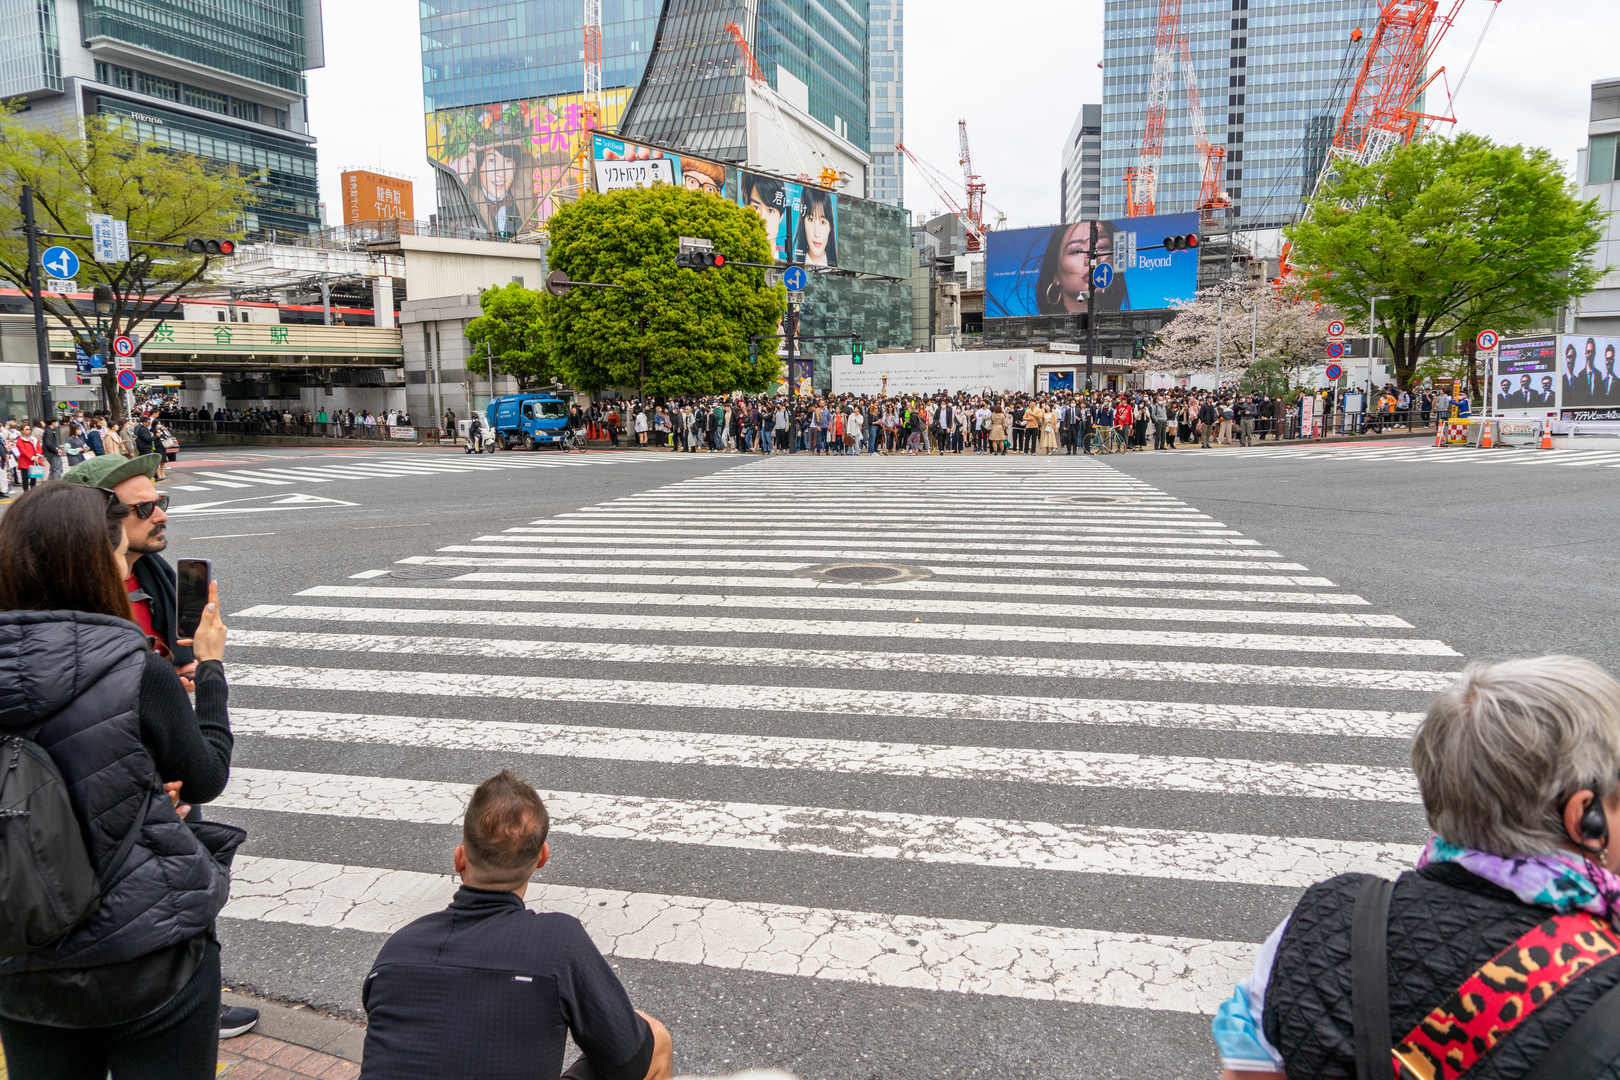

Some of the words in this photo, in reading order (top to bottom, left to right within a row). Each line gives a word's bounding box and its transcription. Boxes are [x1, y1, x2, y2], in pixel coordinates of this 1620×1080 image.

[600, 94, 625, 107] NHK
[131, 111, 163, 125] Hikarie
[602, 140, 624, 151] SoftBank
[604, 167, 647, 182] ソフトバンク
[772, 191, 808, 217] 君に届け
[101, 218, 113, 258] 渋谷駅前
[1139, 254, 1172, 271] Beyond
[153, 323, 290, 345] 渋谷駅
[992, 361, 1008, 370] Beyond
